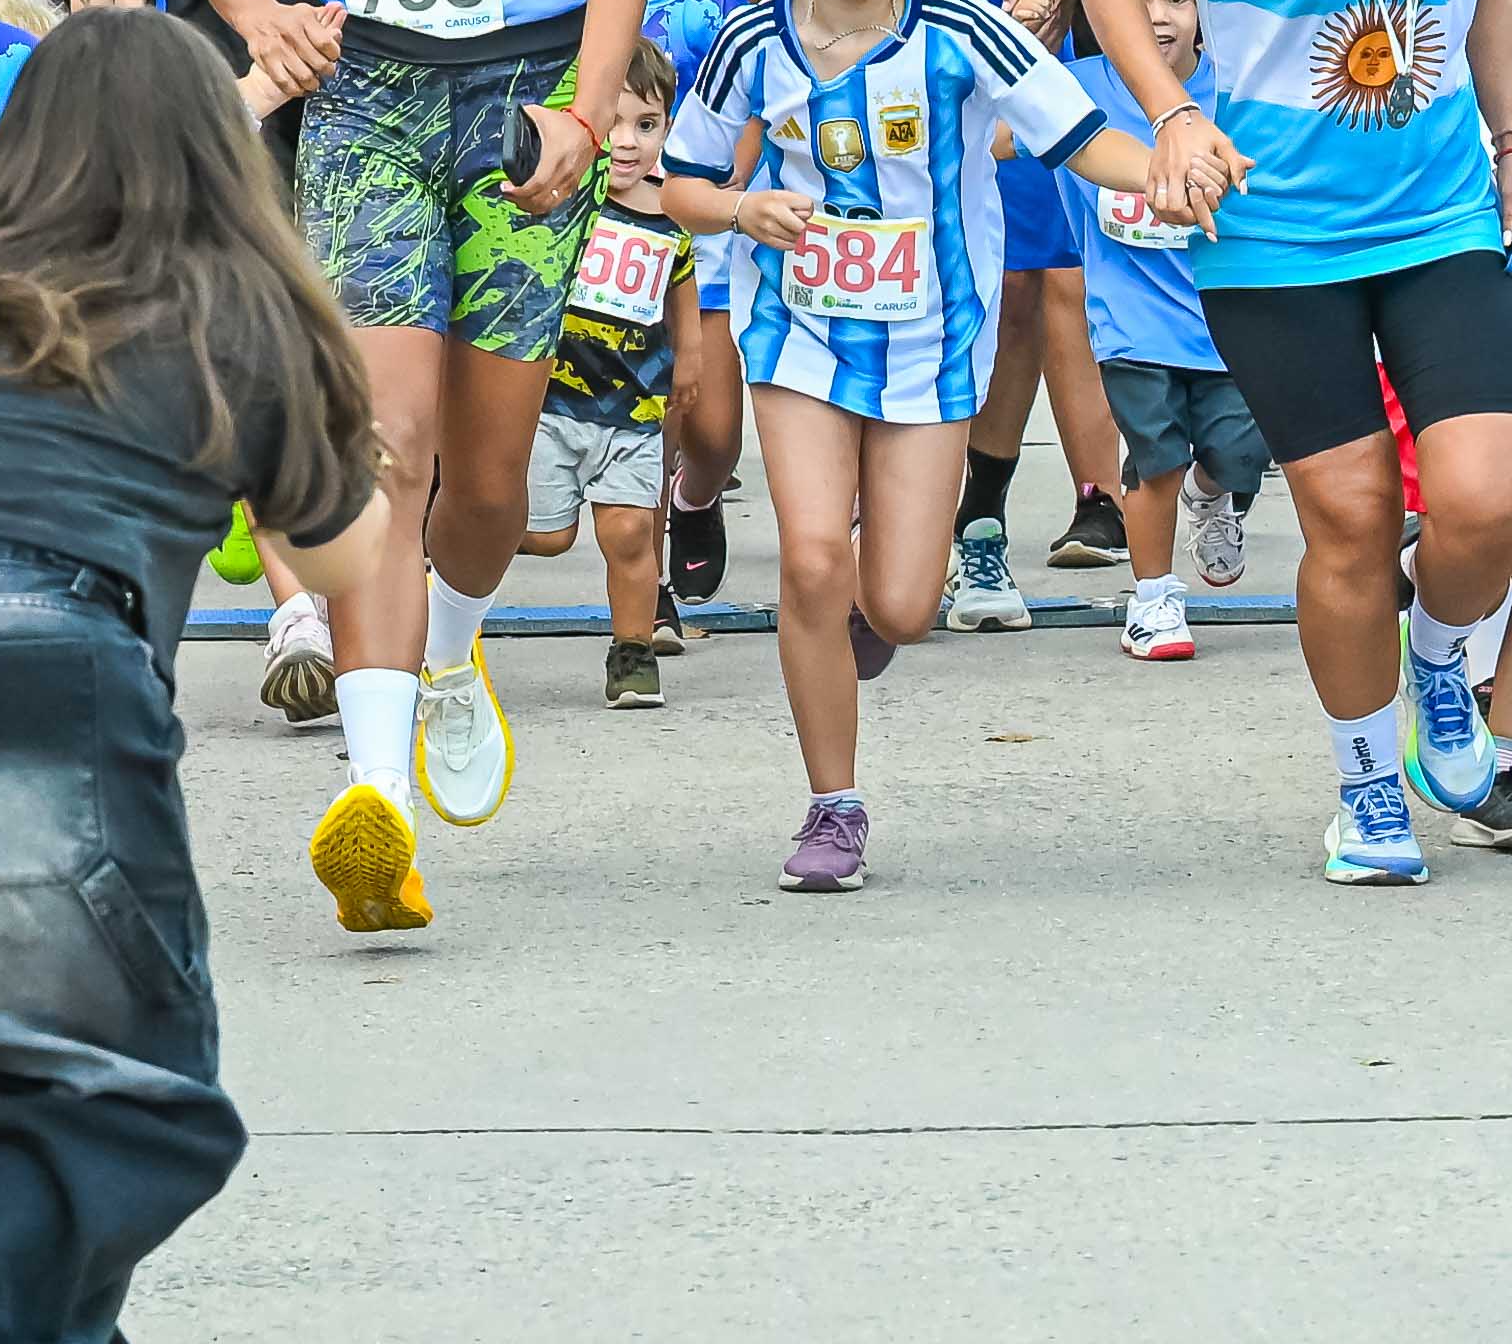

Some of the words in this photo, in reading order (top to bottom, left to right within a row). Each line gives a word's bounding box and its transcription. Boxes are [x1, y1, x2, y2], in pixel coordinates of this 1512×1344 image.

[445, 15, 491, 28] CARUSO
[579, 227, 670, 302] 561
[792, 222, 921, 294] 584
[874, 301, 917, 311] CARUSO
